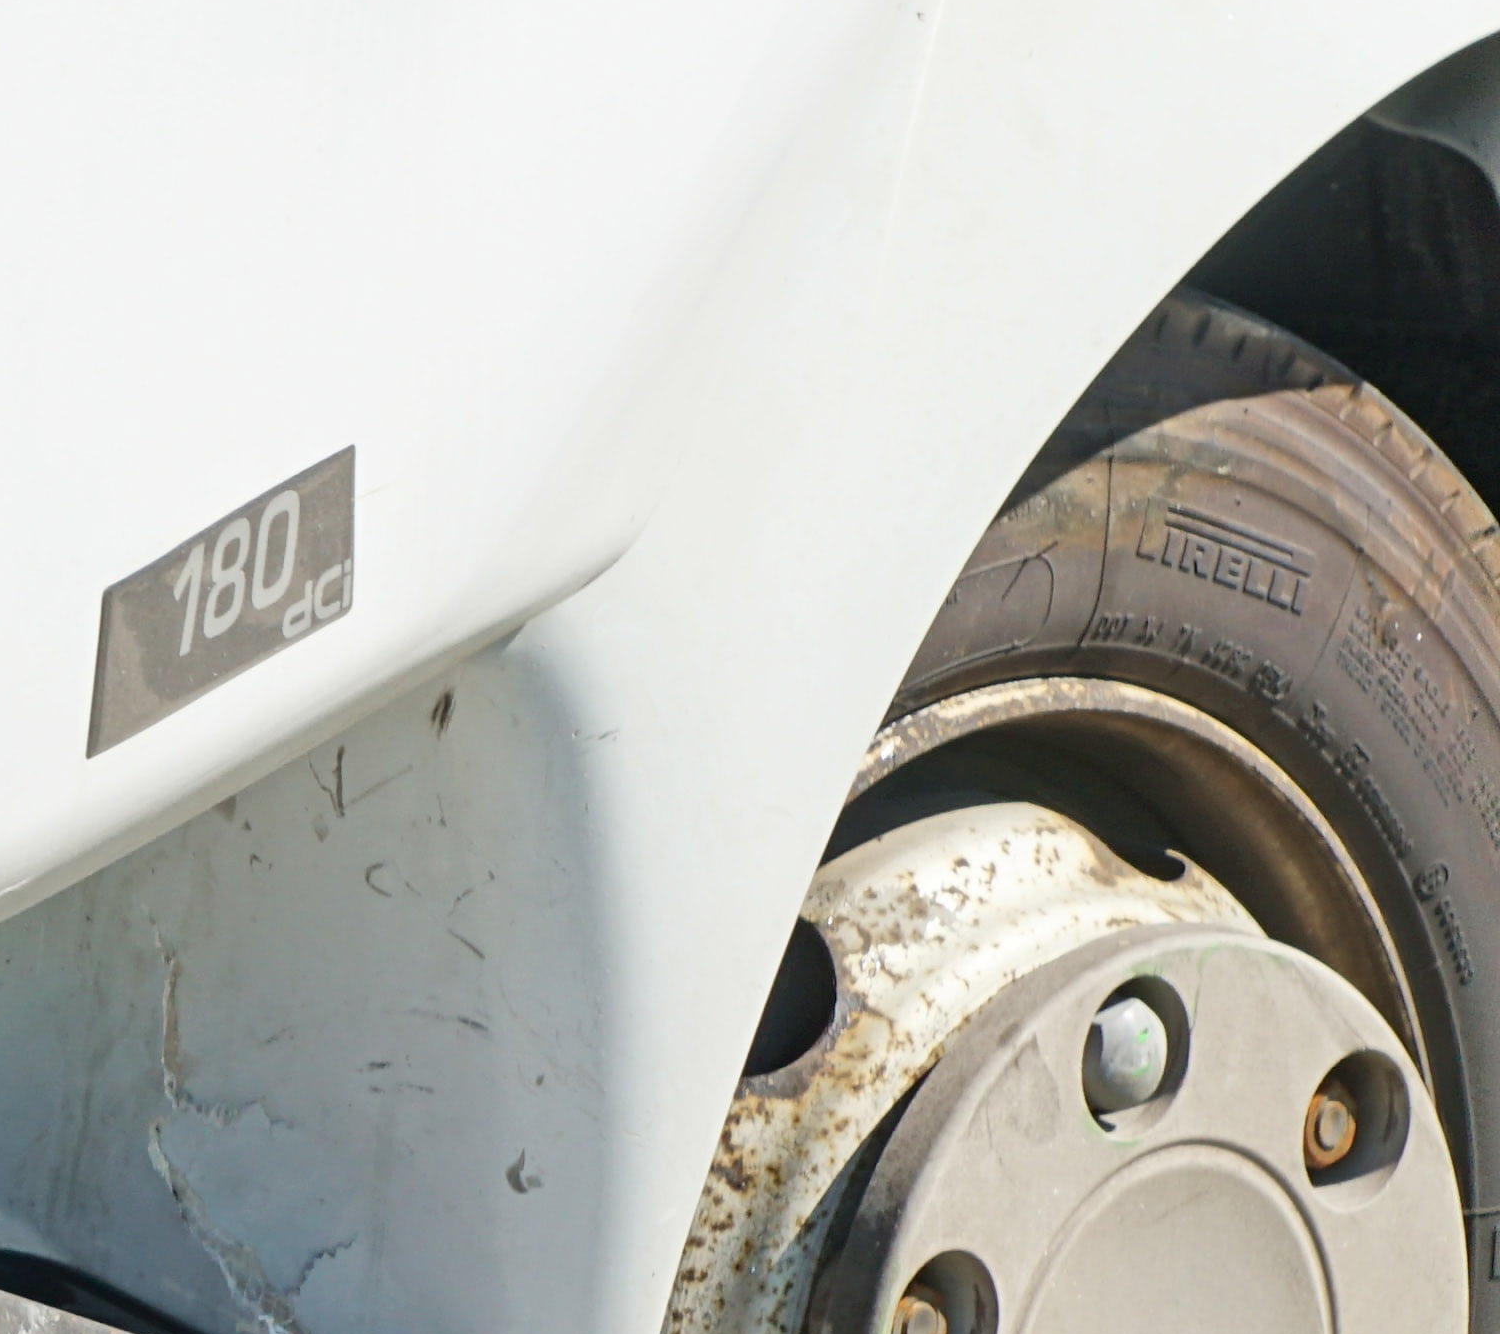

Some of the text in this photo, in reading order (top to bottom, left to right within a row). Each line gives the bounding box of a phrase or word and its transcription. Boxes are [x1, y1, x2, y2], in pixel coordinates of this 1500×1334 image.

[173, 488, 352, 657] 180 dCi
[1135, 501, 1312, 616] PIRELLI
